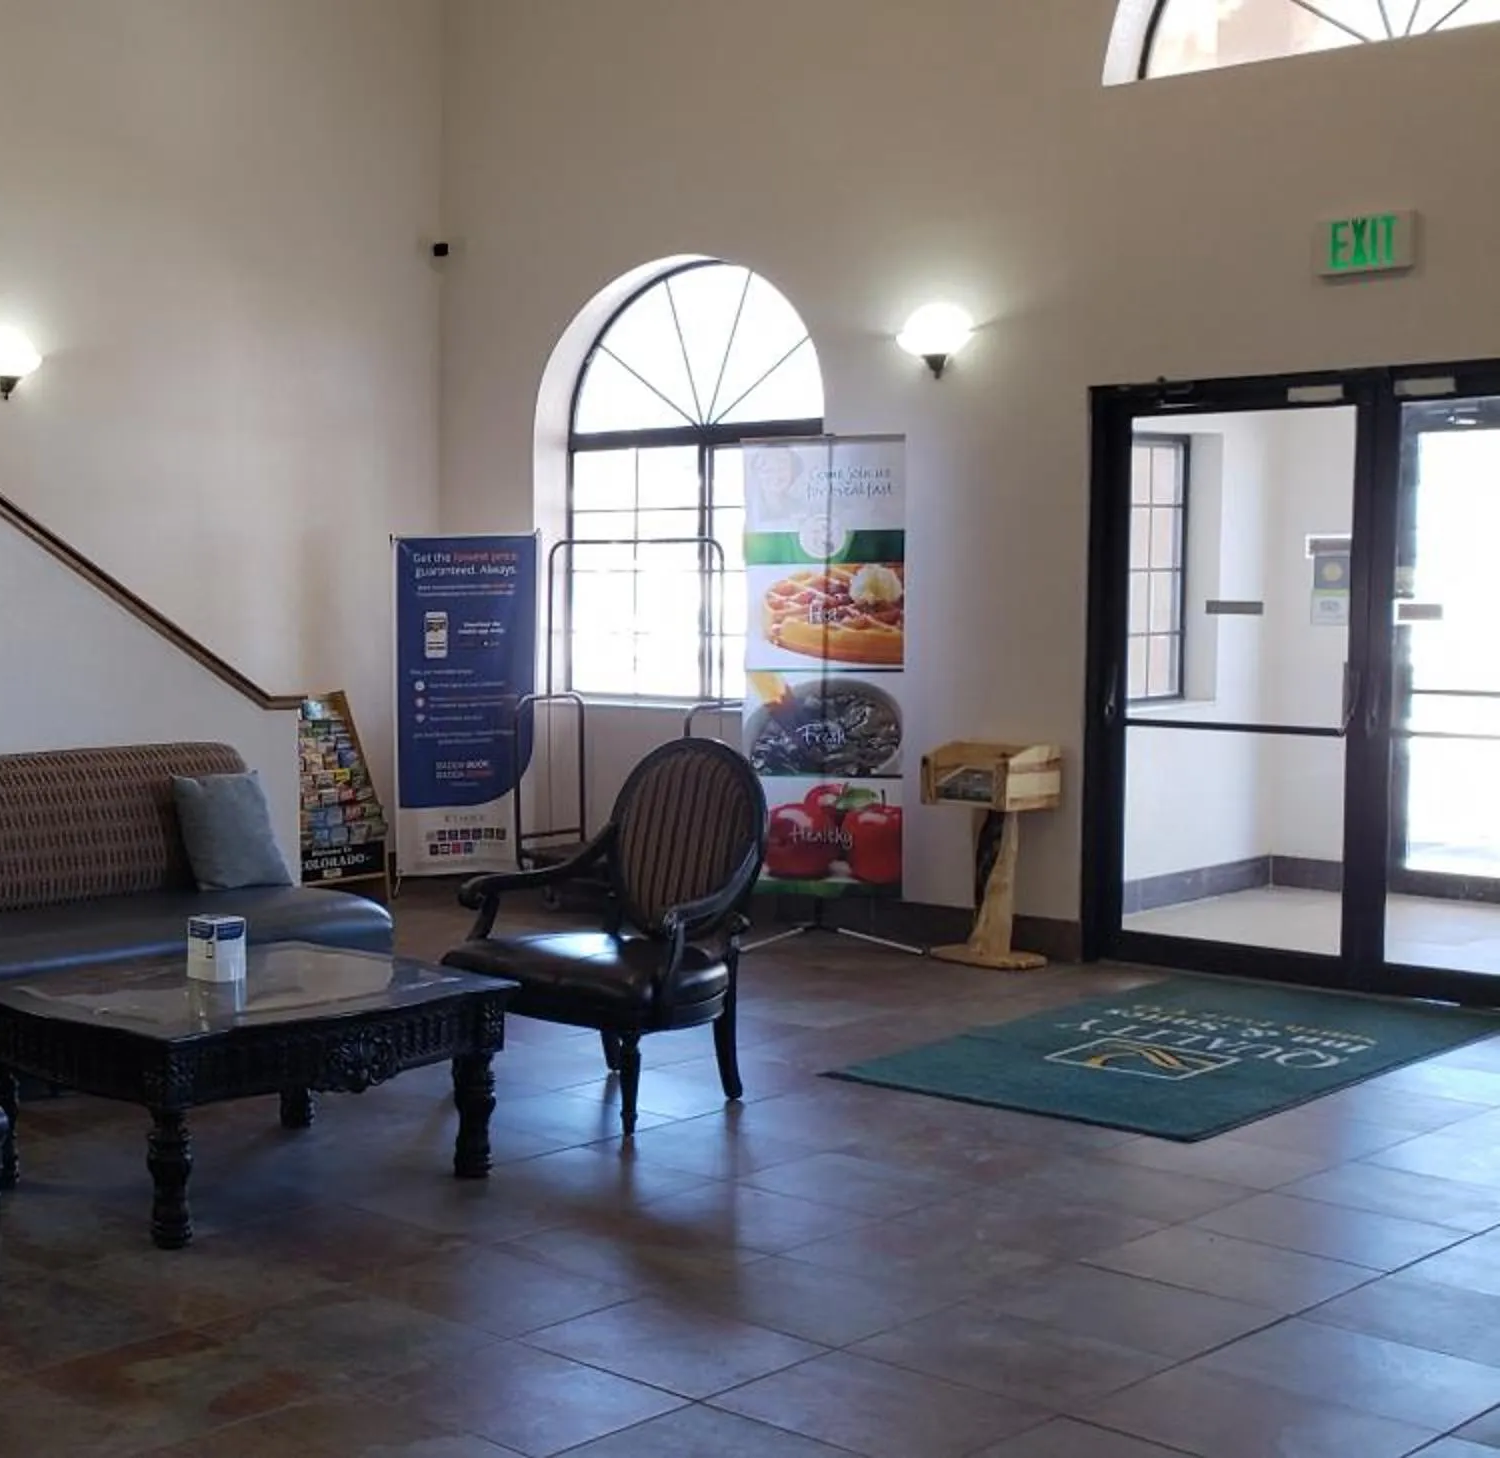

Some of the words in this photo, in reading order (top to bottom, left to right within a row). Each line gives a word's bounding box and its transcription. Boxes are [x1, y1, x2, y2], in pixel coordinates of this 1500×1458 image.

[1330, 213, 1397, 269] EXIT
[875, 466, 891, 479] us
[413, 553, 432, 563] Get
[433, 552, 452, 563] the
[454, 551, 490, 563] lowest
[796, 723, 845, 746] Fresh
[788, 823, 853, 849] Healthy
[1055, 1017, 1349, 1069] QUALITY
[1240, 1027, 1281, 1038] &
[1290, 1034, 1370, 1053] Inn
